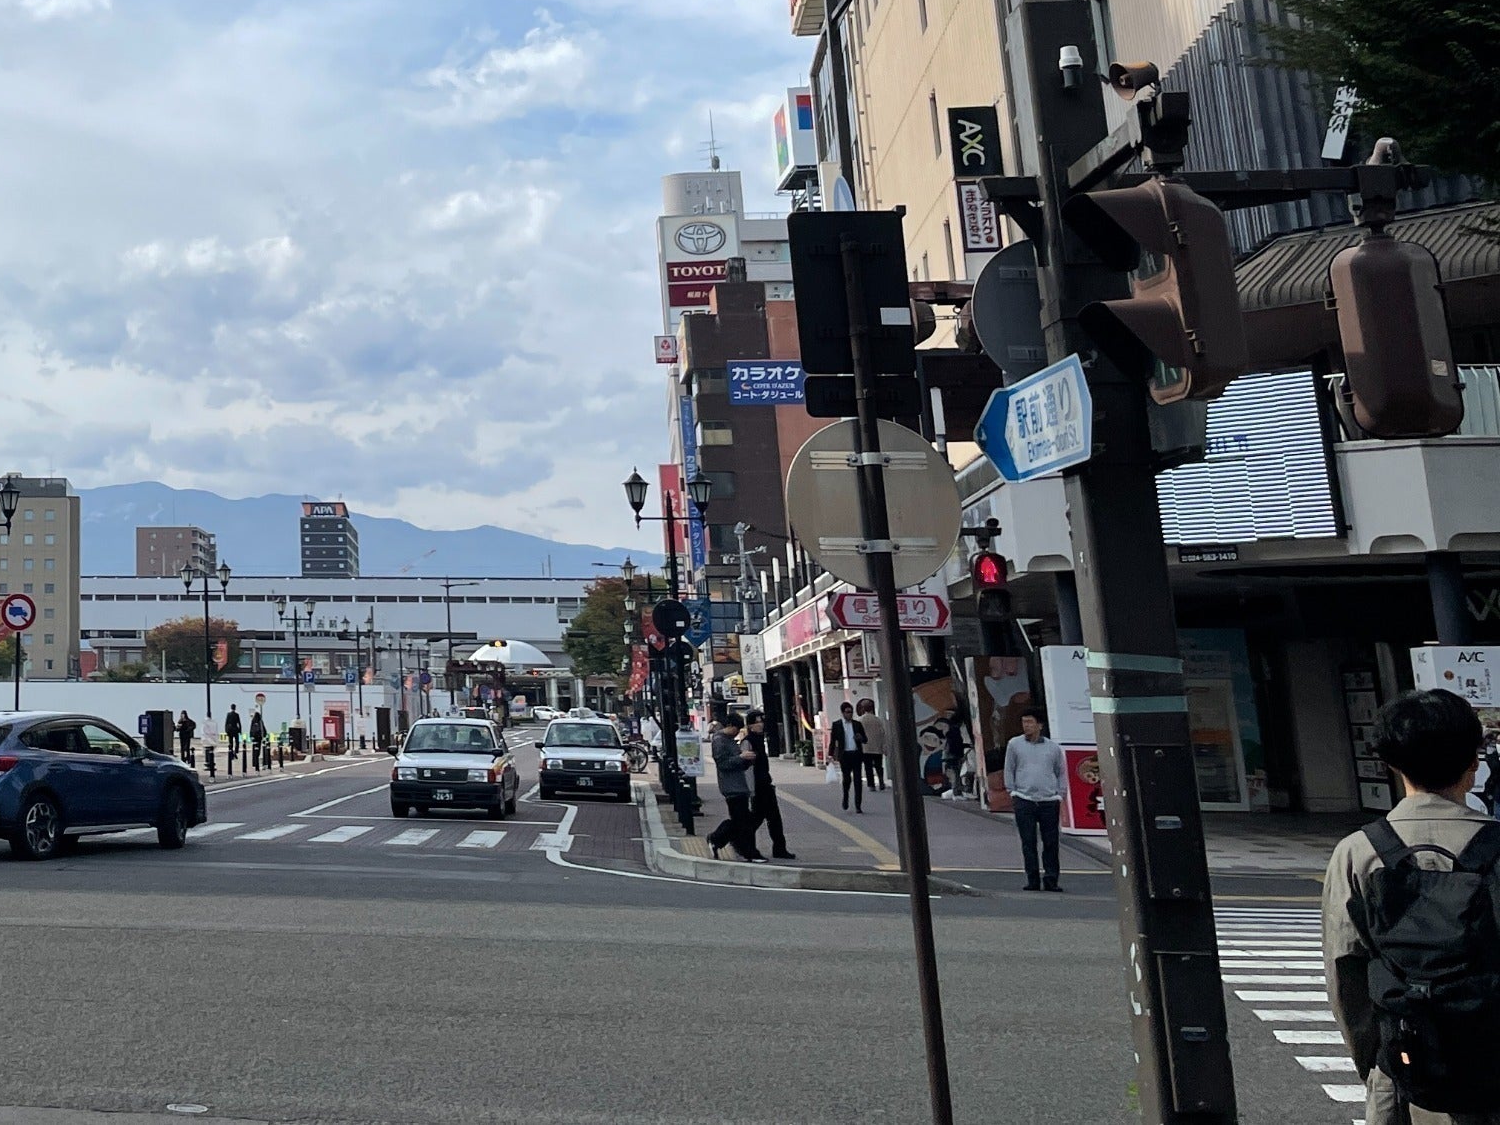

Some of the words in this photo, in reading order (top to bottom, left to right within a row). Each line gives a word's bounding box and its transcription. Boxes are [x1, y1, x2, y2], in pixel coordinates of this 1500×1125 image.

[958, 119, 986, 167] AXC
[670, 265, 727, 277] TOYOT
[731, 366, 801, 381] カラオケ
[733, 390, 804, 400] コート・ダジュール
[1015, 377, 1072, 439] 駅前通り
[313, 506, 334, 514] APA
